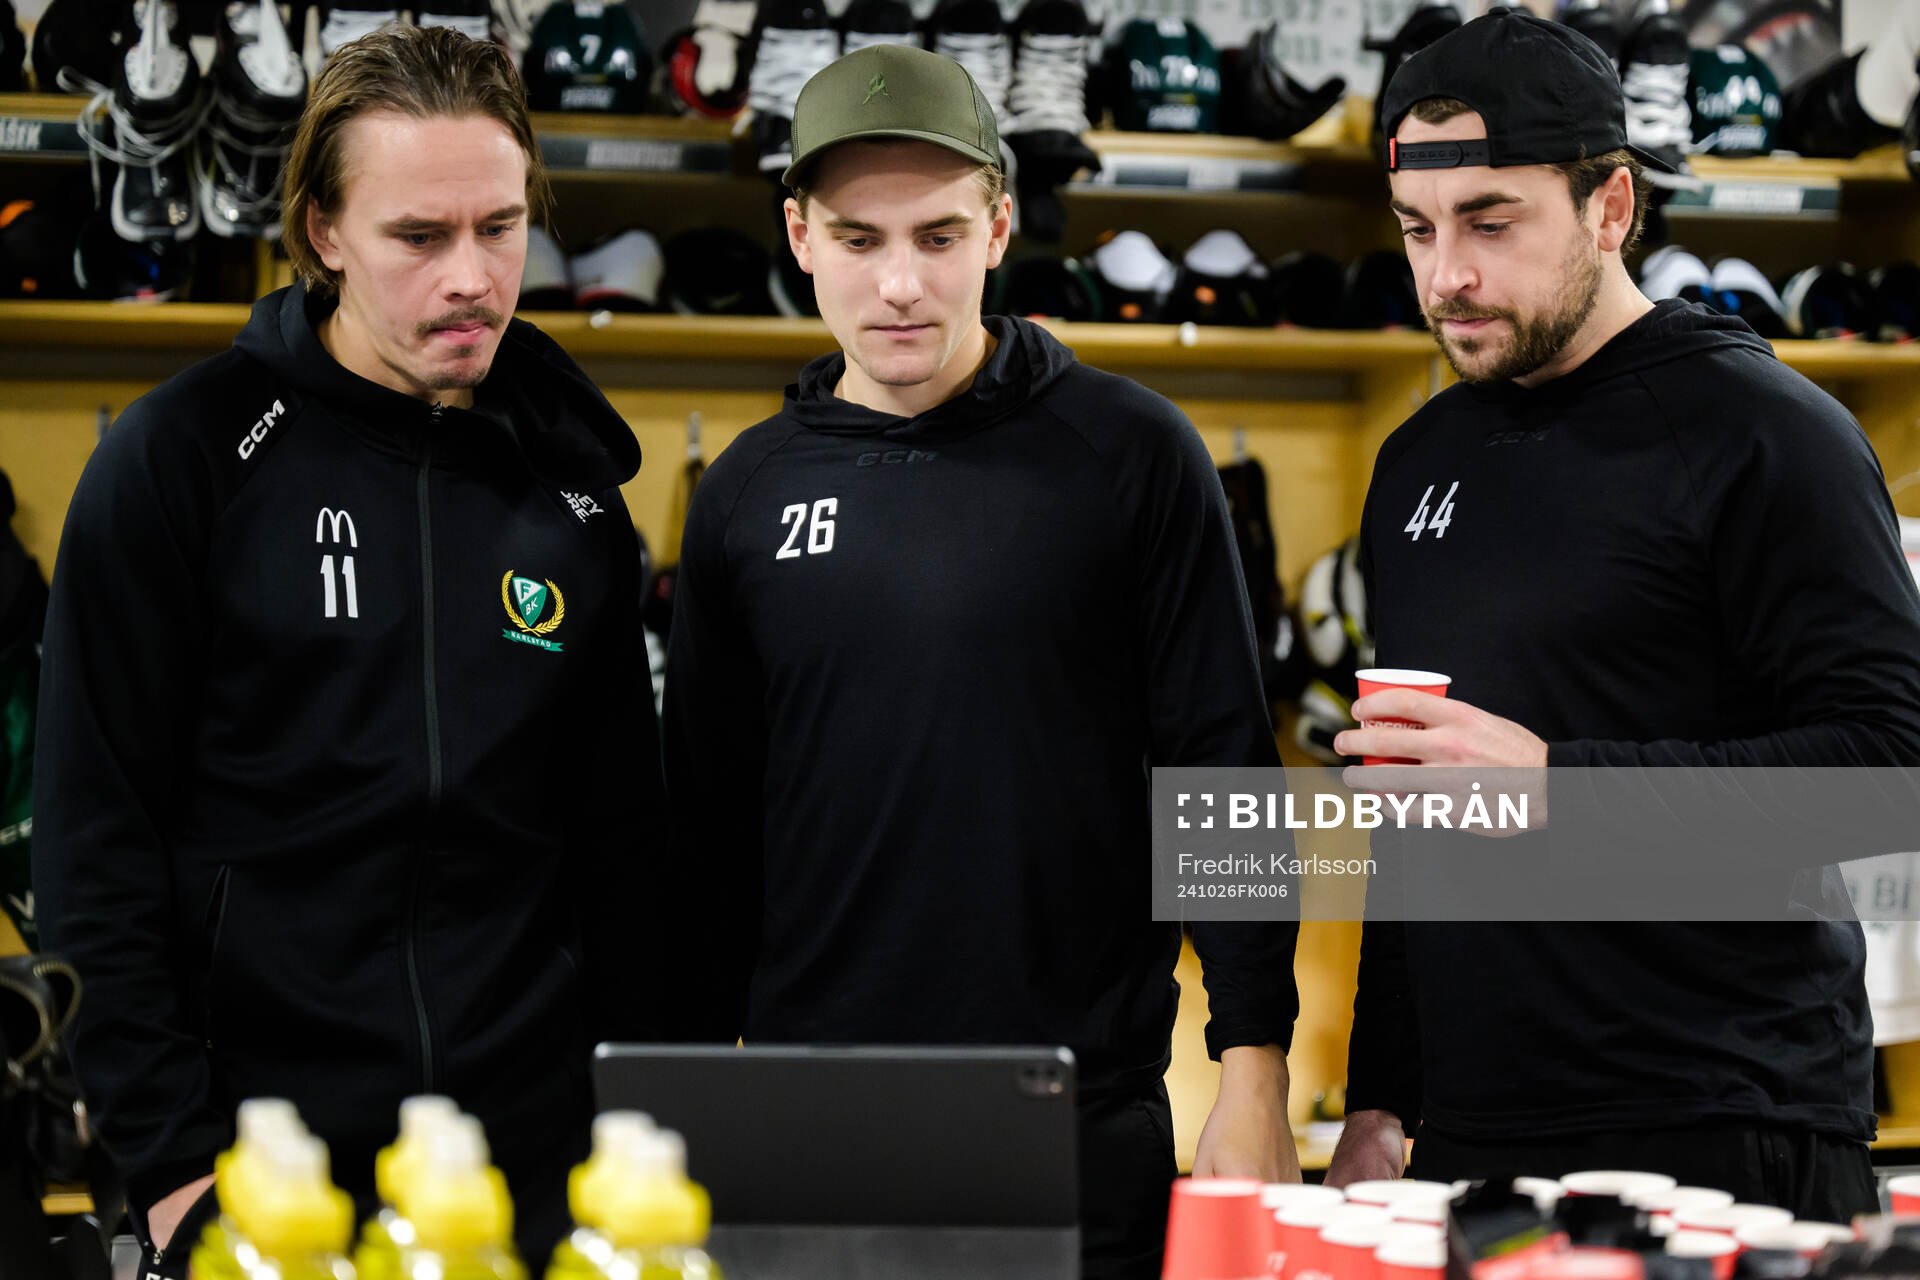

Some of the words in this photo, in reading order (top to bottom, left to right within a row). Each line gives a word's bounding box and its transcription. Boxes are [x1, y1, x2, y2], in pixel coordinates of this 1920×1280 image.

[237, 399, 286, 460] CCM
[856, 449, 938, 468] CCM
[775, 496, 839, 561] 26
[1403, 480, 1460, 542] 44
[319, 554, 359, 619] 11
